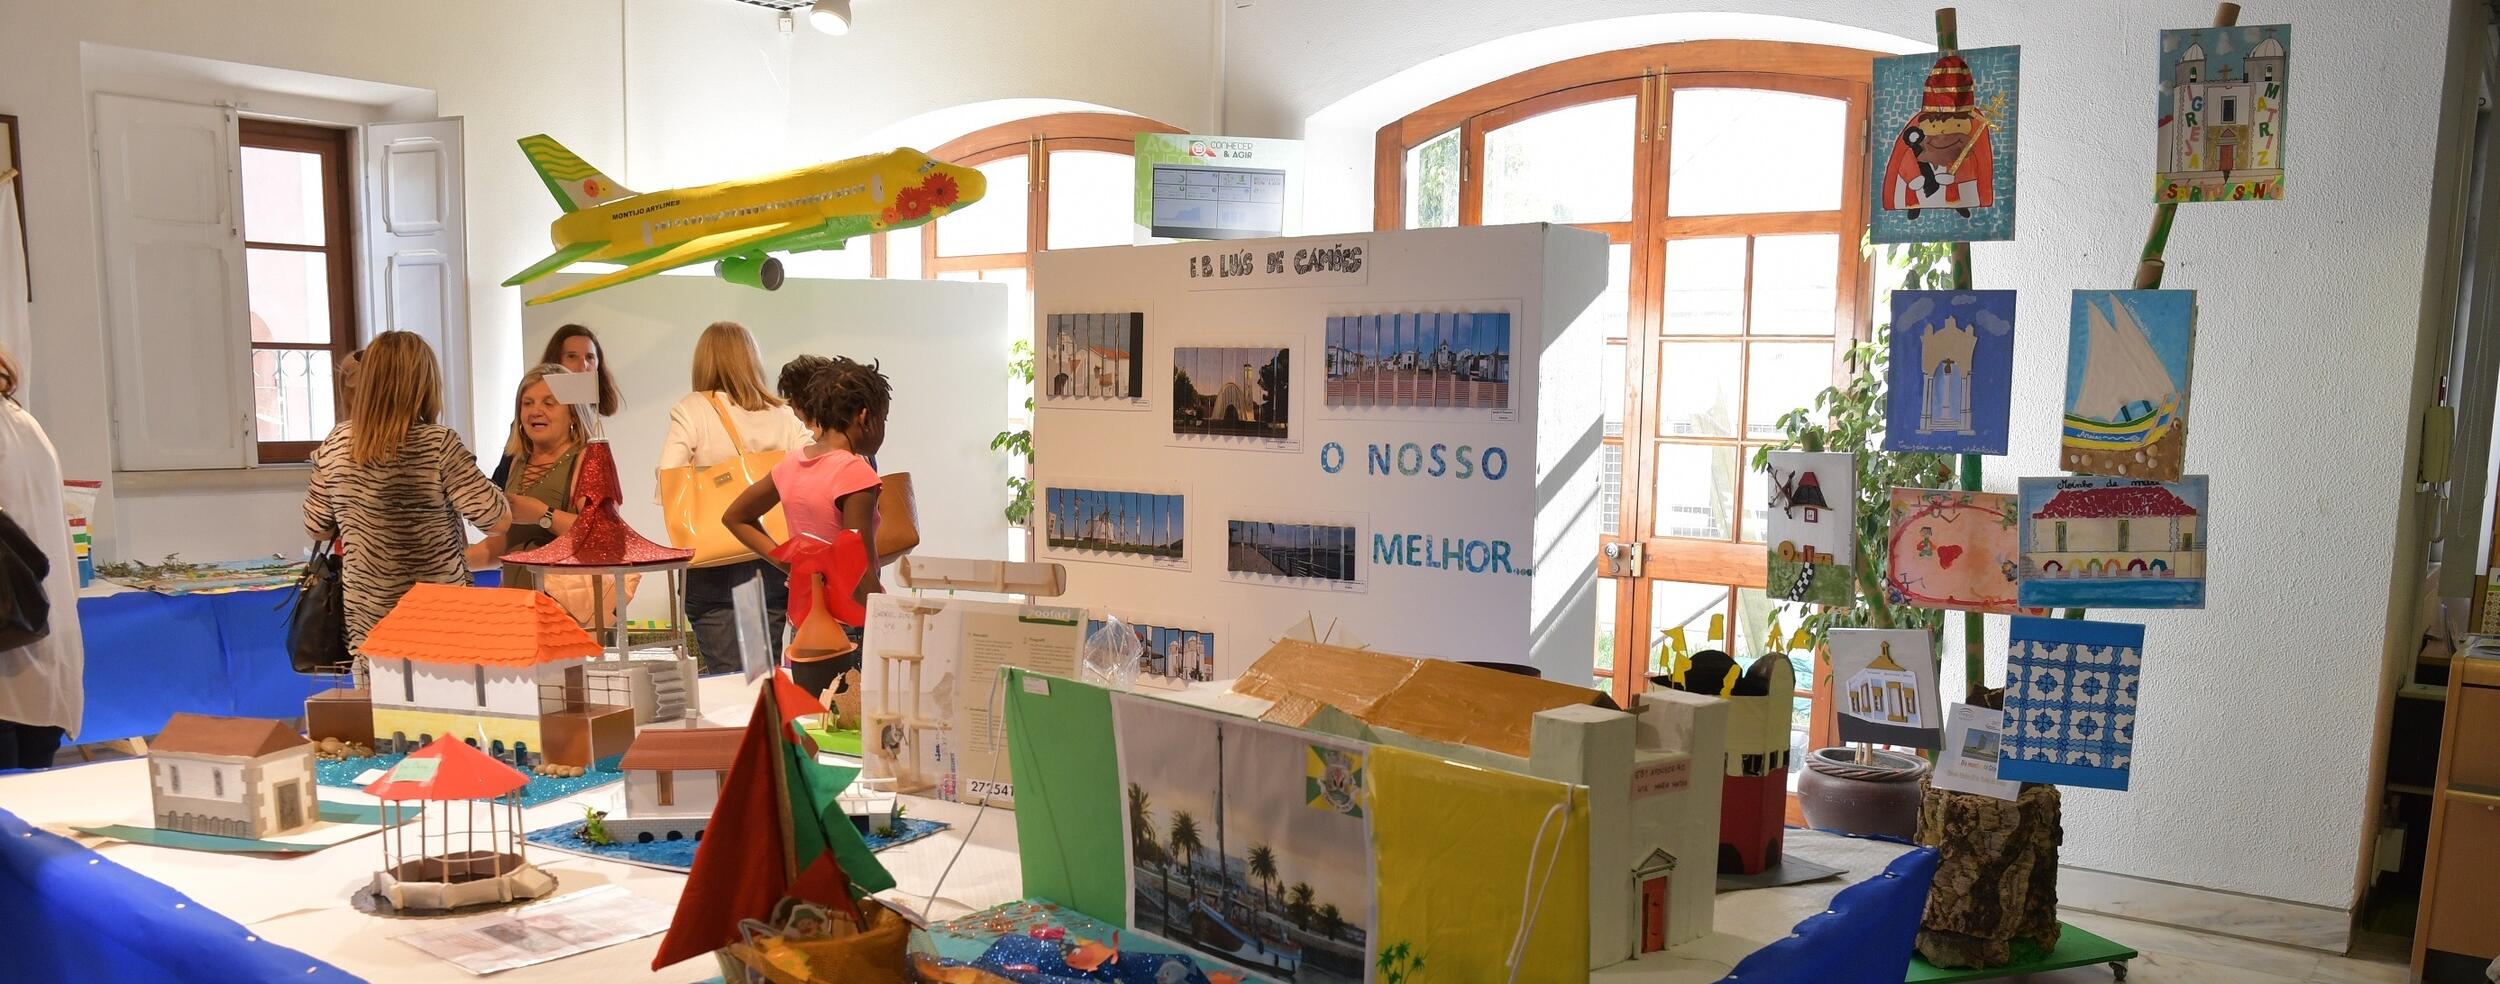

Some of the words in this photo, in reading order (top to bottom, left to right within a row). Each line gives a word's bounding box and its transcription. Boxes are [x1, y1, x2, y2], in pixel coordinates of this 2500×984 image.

[2256, 82, 2280, 167] MATRIZ
[1210, 140, 1253, 150] CONHECER
[1232, 151, 1253, 159] AGIR
[612, 208, 644, 220] MONTIJO
[645, 199, 680, 214] ARYLINES
[1219, 249, 1254, 278] LUÍS
[1266, 250, 1285, 274] DE
[1293, 243, 1363, 275] CAMÕES
[1320, 442, 1345, 474] O
[1368, 442, 1508, 481] NOSSO
[2057, 479, 2094, 490] Moinho
[2106, 479, 2119, 488] de
